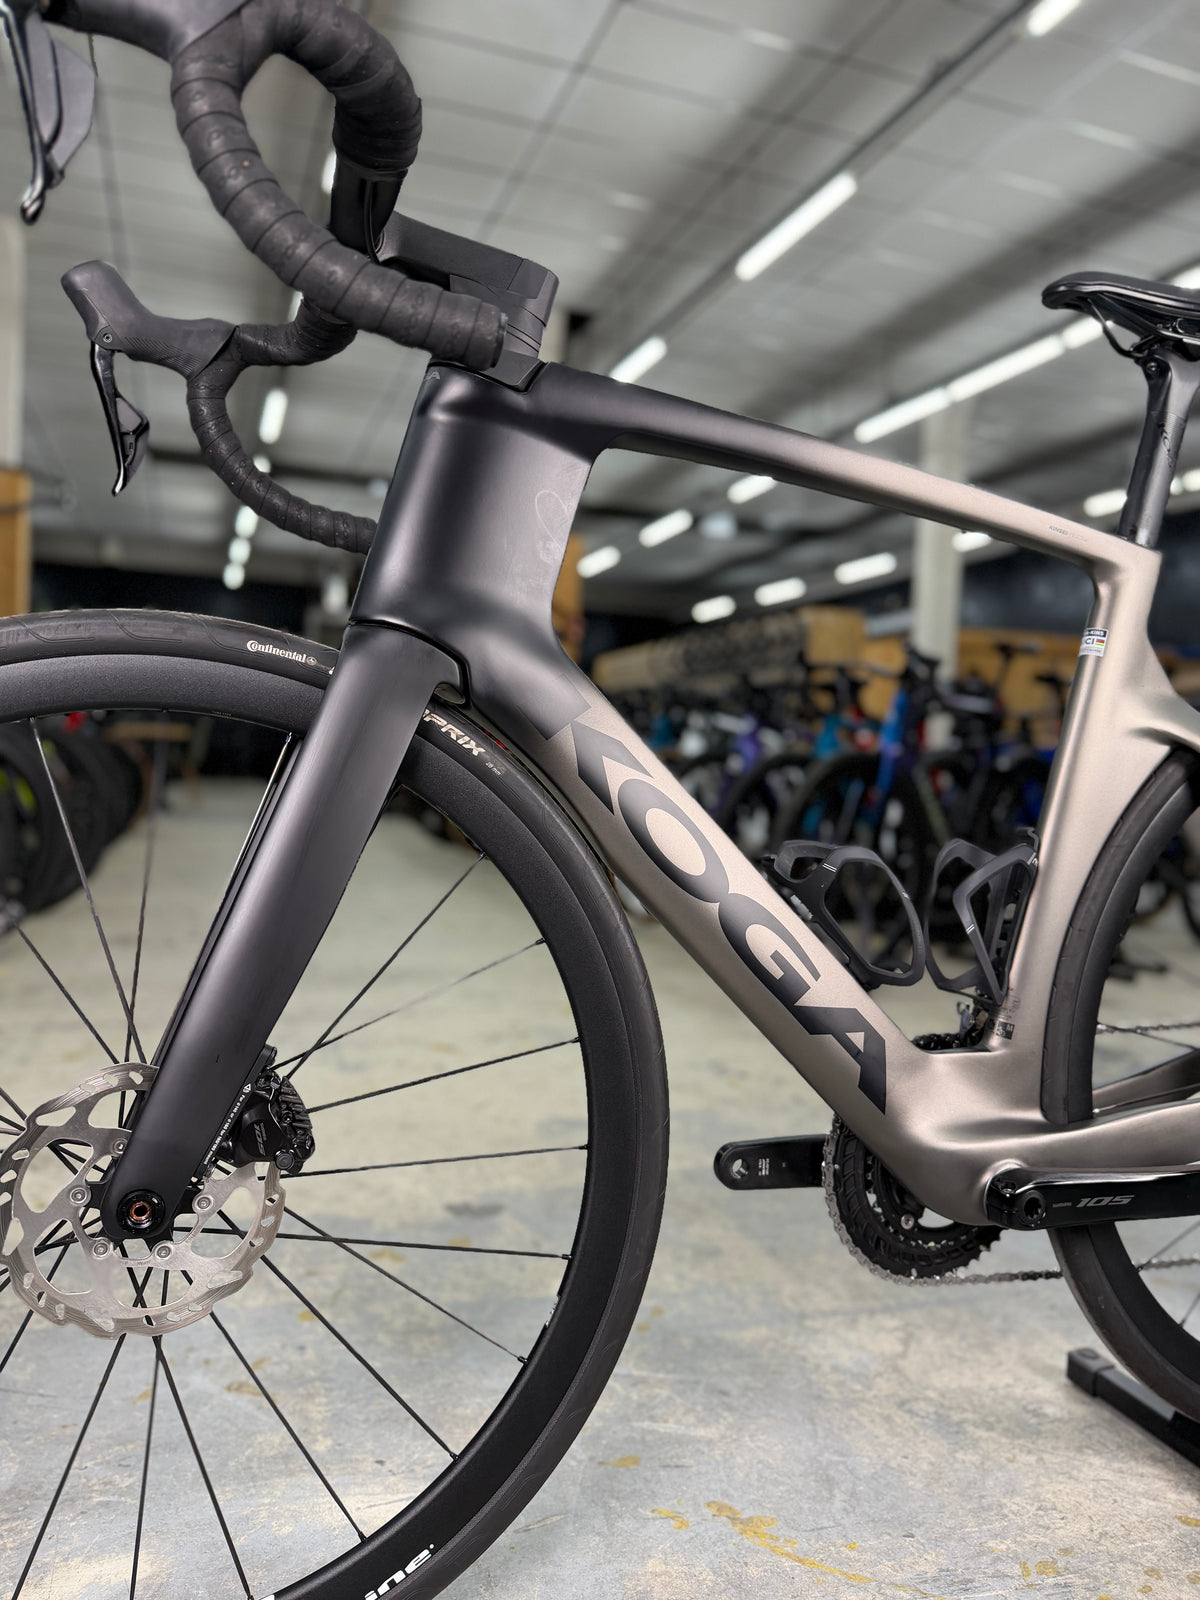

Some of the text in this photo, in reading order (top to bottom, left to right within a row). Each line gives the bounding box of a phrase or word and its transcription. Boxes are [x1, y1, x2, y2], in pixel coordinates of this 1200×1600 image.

[246, 640, 307, 663] Continental
[423, 709, 486, 757] PRIX
[516, 673, 886, 1115] KOGA
[1076, 1195, 1135, 1208] 105
